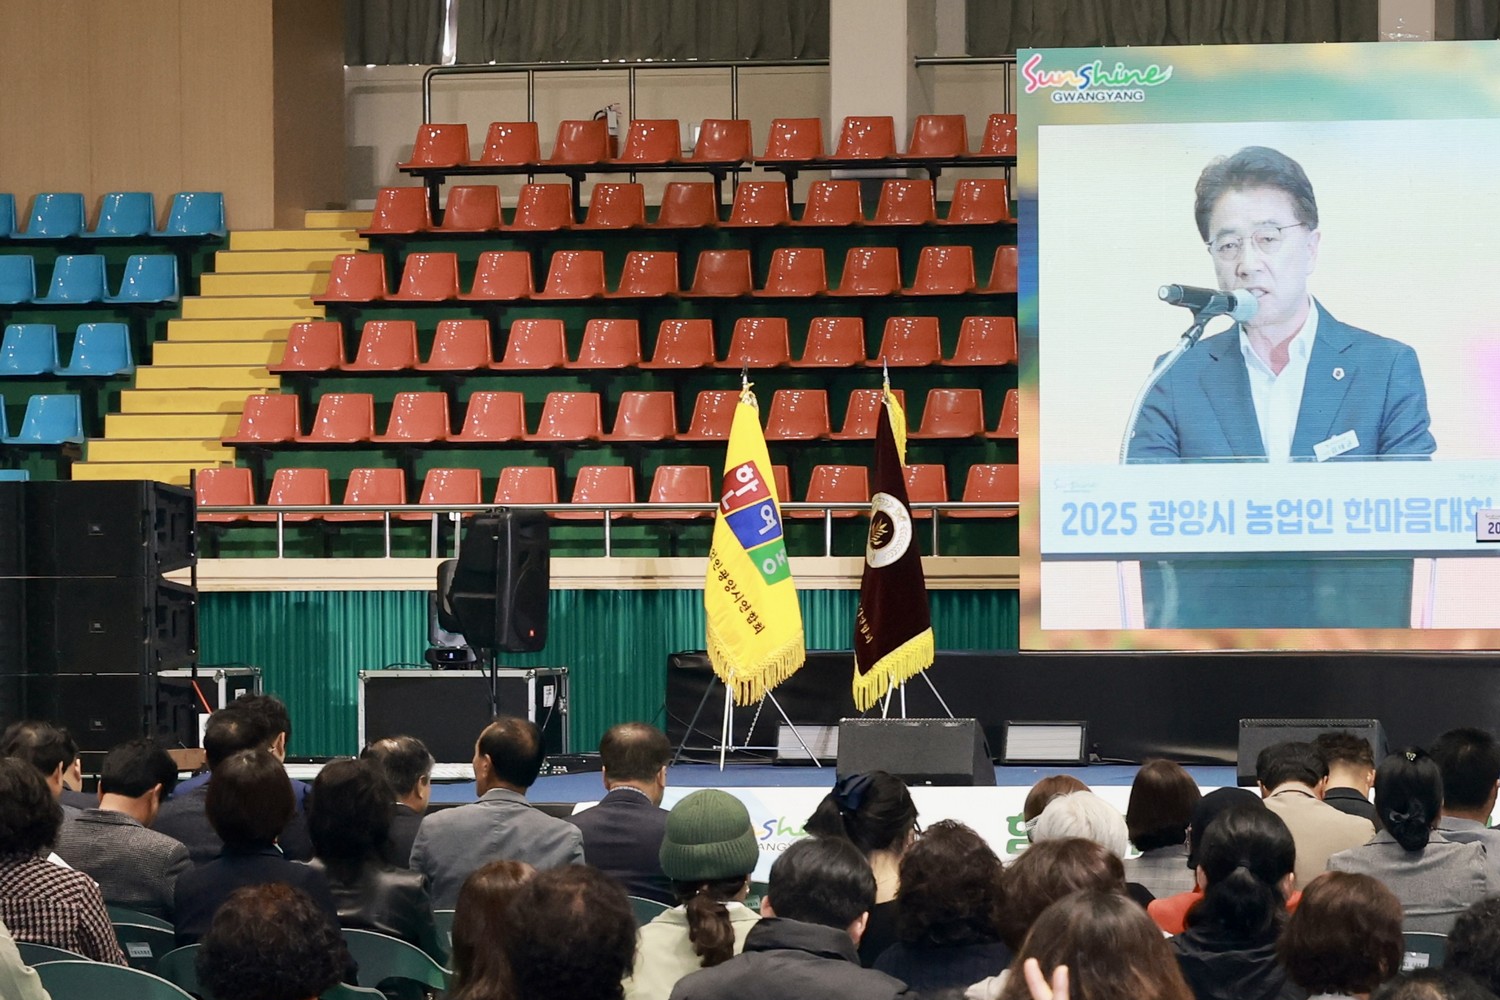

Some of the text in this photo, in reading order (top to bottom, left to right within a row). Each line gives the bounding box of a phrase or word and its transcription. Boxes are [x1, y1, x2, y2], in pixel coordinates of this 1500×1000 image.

[1024, 55, 1171, 92] Sunshine
[1053, 91, 1143, 102] GWANGYANG
[1061, 501, 1138, 536] 2025
[1147, 500, 1236, 535] 광양시
[1245, 499, 1334, 534] 농업인
